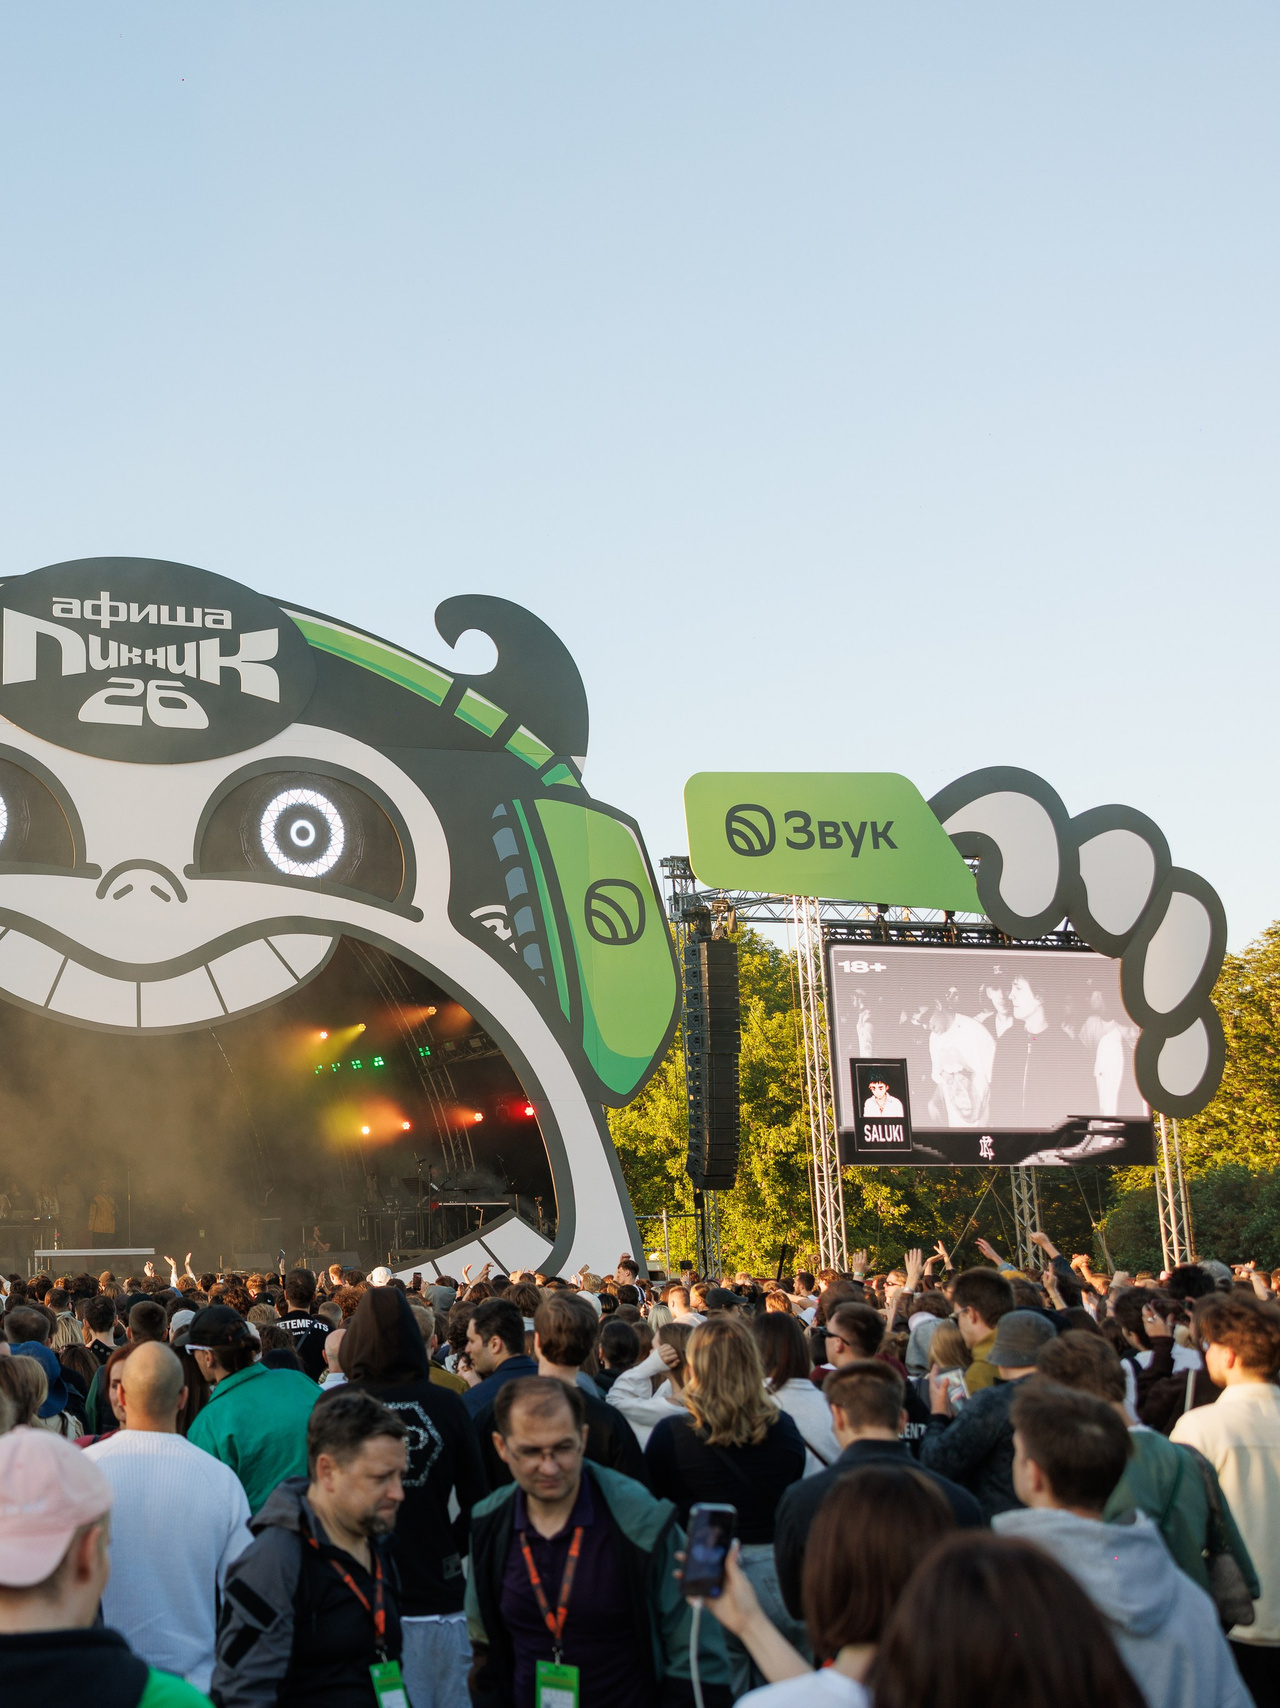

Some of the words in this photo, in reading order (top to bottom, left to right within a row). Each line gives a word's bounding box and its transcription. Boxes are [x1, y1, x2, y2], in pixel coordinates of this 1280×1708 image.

[52, 591, 232, 630] афиша
[78, 676, 209, 730] 26
[785, 811, 898, 857] Звук
[838, 961, 887, 974] 18+
[864, 1124, 904, 1142] SALUKI
